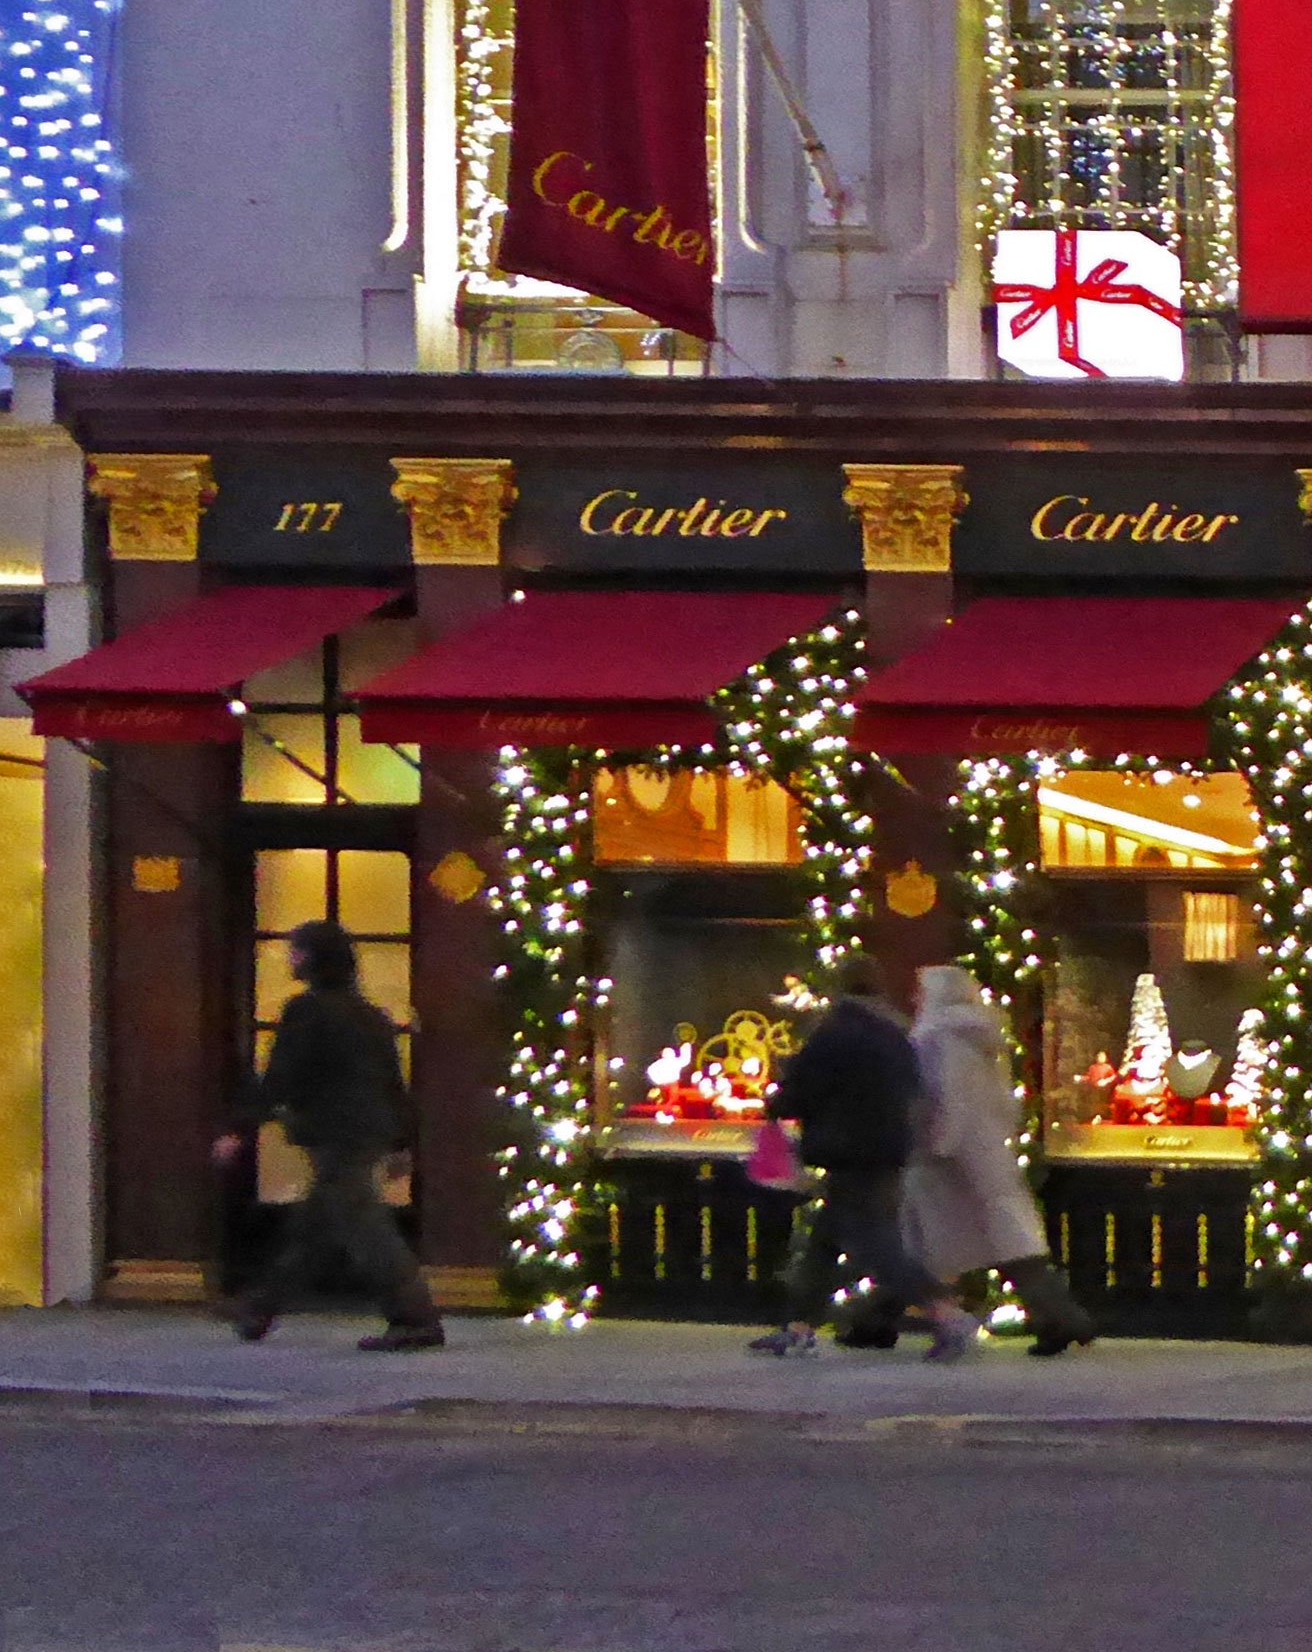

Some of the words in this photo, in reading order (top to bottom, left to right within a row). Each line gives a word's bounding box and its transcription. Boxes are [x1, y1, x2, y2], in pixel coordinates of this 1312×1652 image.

[532, 151, 708, 265] Cartier
[277, 502, 342, 532] 177
[580, 490, 787, 538] Cartier
[1031, 495, 1239, 543] Cartier
